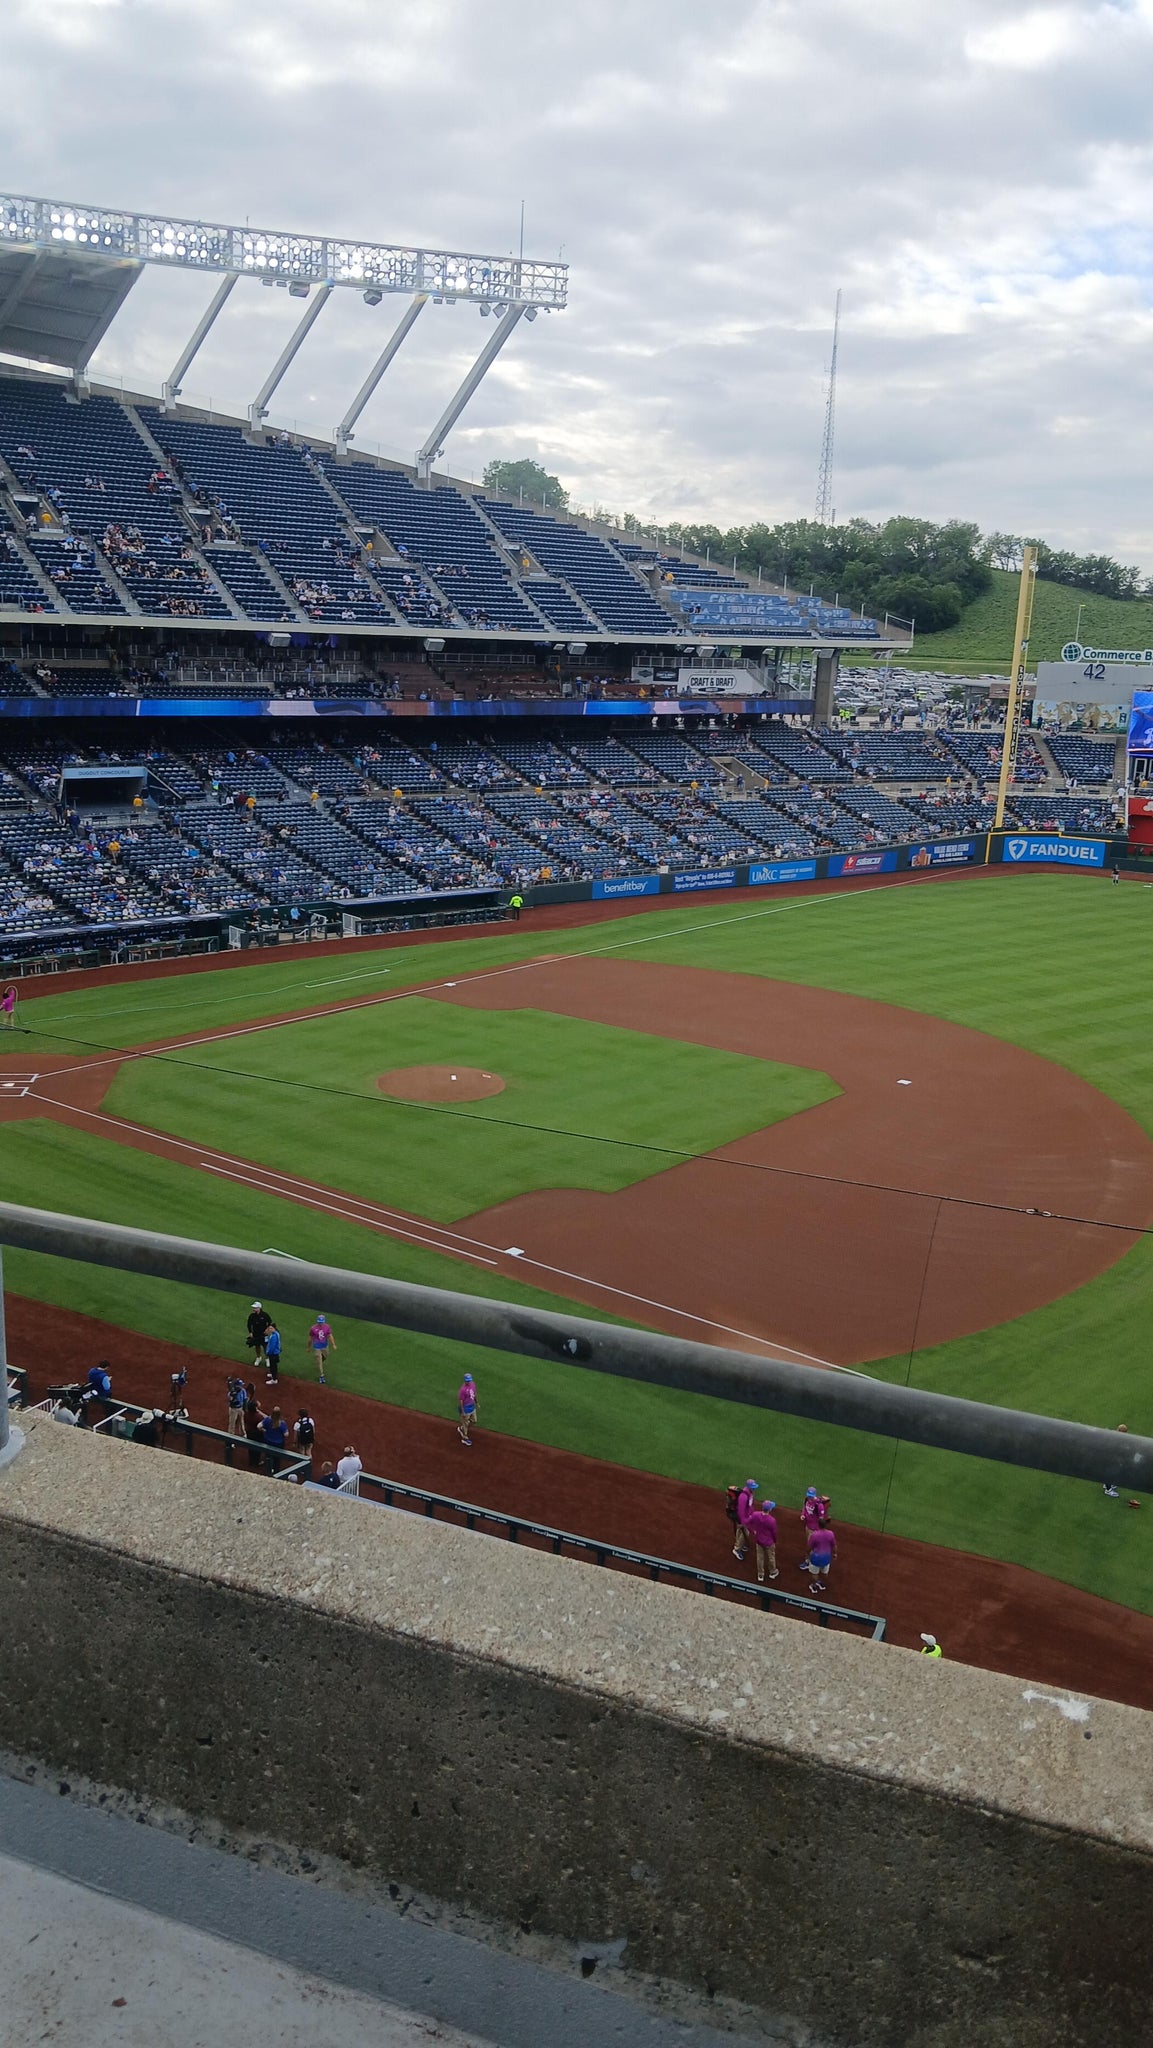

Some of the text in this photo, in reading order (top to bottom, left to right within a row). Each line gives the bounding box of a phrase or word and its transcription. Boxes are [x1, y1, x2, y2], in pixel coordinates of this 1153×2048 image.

[1083, 649, 1142, 660] Commerce
[1083, 663, 1106, 680] 42
[690, 677, 734, 687] CRAFT & DRAFT
[1029, 843, 1099, 860] FANDUEL
[752, 869, 778, 882] UMKC
[604, 881, 647, 893] benefitbay
